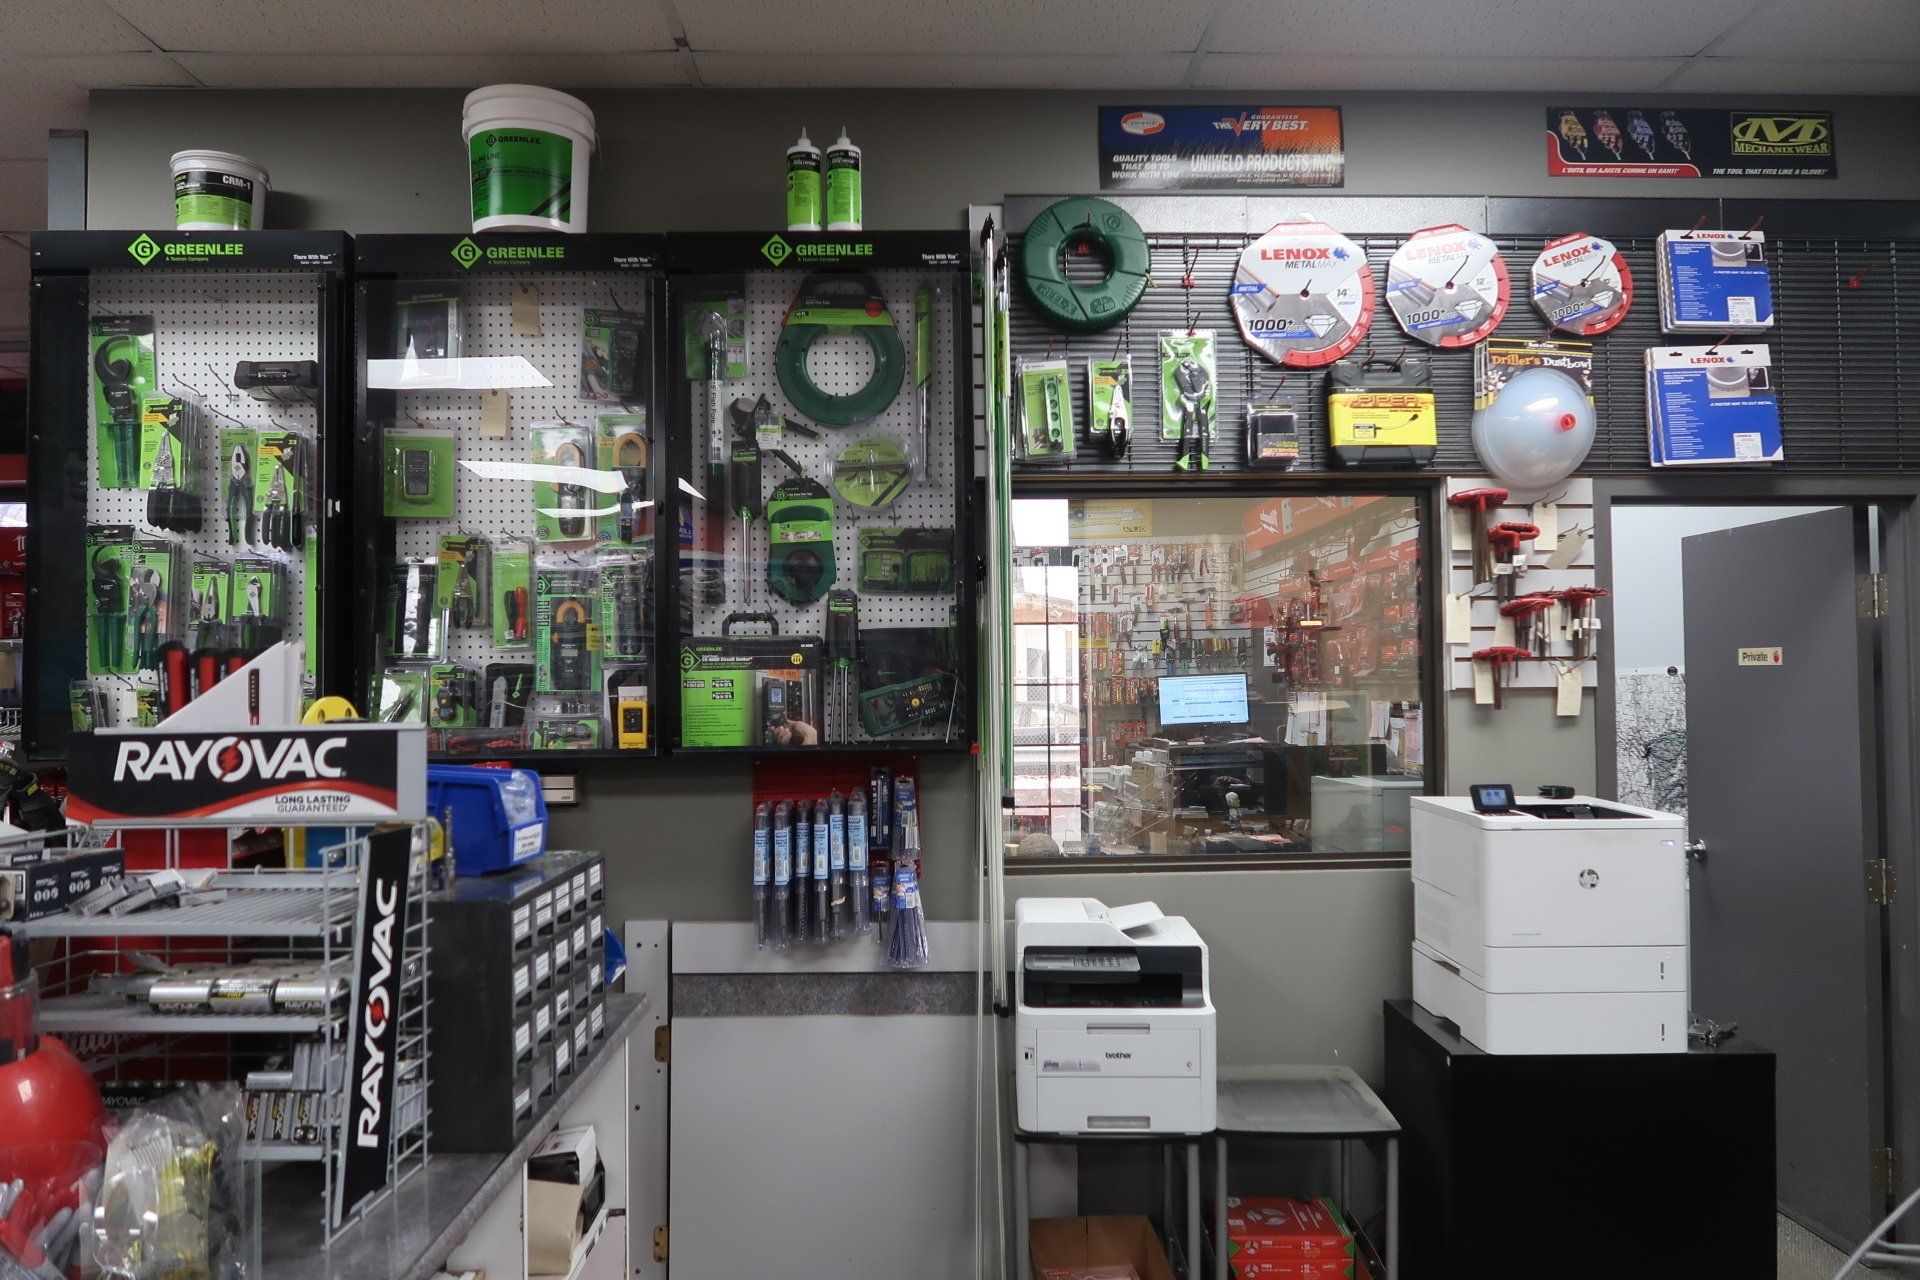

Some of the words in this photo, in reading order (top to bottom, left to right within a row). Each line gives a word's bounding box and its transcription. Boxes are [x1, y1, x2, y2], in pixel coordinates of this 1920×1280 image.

[1212, 121, 1233, 130] THE
[1272, 120, 1307, 131] BEST
[1734, 142, 1794, 154] MECHANIX
[1795, 141, 1829, 154] WEAR
[1112, 154, 1149, 163] QUALITY
[1150, 154, 1178, 163] TOOLS
[1190, 154, 1243, 172] UNIWELD
[1120, 163, 1143, 171] THAT
[1111, 170, 1137, 179] WORK
[1139, 170, 1161, 178] WITH
[1162, 170, 1180, 178] YOU
[222, 175, 251, 190] CRM-1
[164, 243, 244, 256] GREENLEE
[486, 246, 565, 259] GREENLEE
[795, 243, 873, 256] GREENLEE
[1261, 248, 1331, 260] LENOX
[1406, 241, 1467, 261] LENOX
[1543, 245, 1591, 268] LENOX
[1406, 309, 1446, 325] 1000+
[1249, 319, 1294, 331] 1000+
[1491, 354, 1541, 366] Driller's
[1542, 356, 1593, 370] Dustbowl
[1742, 651, 1768, 662] Private
[113, 736, 348, 783] RAYOVAC
[274, 795, 304, 805] LONG
[306, 795, 351, 805] LASTING
[277, 804, 348, 814] GUARANTEED
[356, 878, 398, 1148] RAYOVAC
[1105, 1051, 1132, 1060] brother
